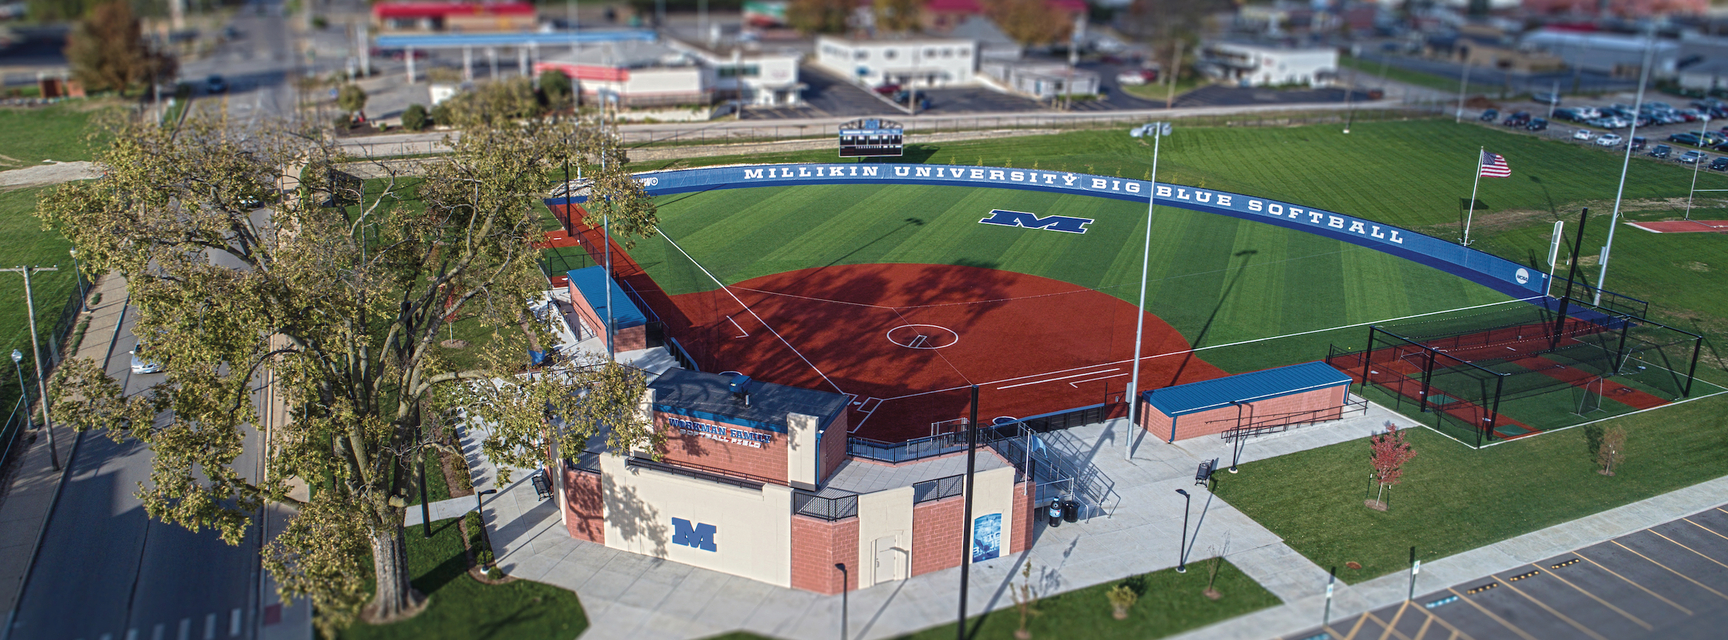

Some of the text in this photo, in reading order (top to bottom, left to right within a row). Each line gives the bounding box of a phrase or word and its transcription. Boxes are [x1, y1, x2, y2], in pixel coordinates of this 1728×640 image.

[744, 166, 1403, 244] MILLIKIN UNIVERSITY BIG BLUE SOFTBALL
[978, 209, 1095, 234] M
[668, 417, 772, 444] WORKMAN FAMILY
[680, 429, 762, 449] SOFTBALL FIELD
[672, 517, 717, 552] M
